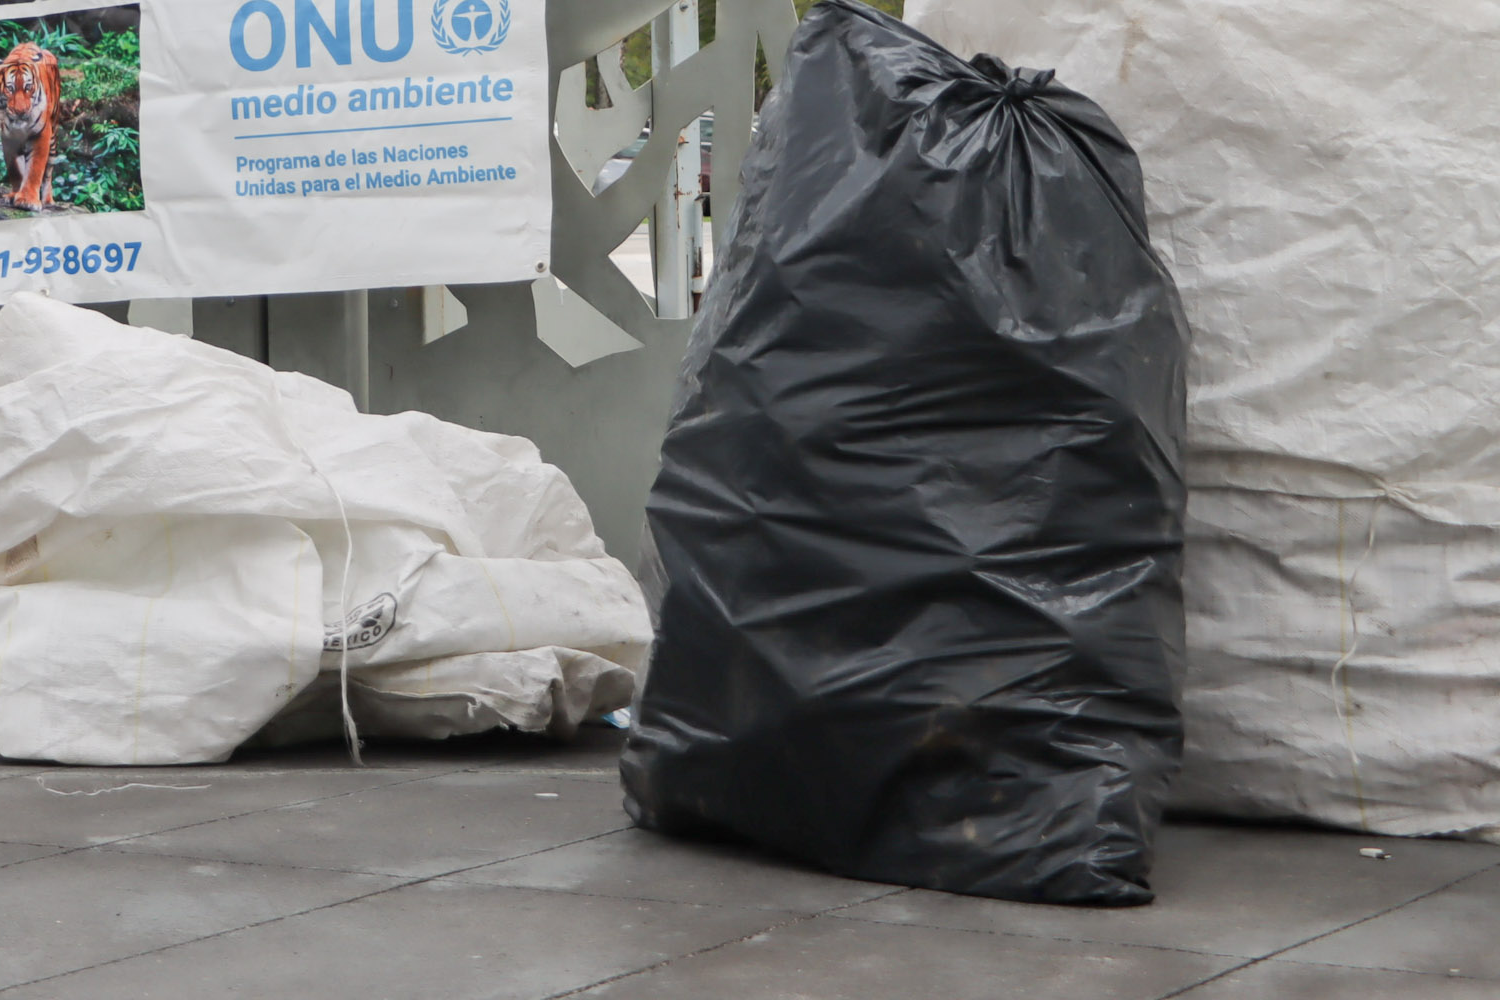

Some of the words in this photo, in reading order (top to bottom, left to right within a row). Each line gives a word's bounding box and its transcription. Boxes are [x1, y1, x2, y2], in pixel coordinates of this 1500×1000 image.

[231, 85, 338, 121] medio
[348, 74, 514, 113] ambiente
[235, 151, 321, 175] Programa
[325, 150, 347, 167] de
[352, 148, 378, 165] las
[383, 144, 469, 163] Naciones
[235, 178, 297, 197] Unidas
[301, 176, 341, 197] para
[345, 173, 361, 191] el
[366, 169, 422, 189] Medio
[426, 165, 517, 185] Ambiente
